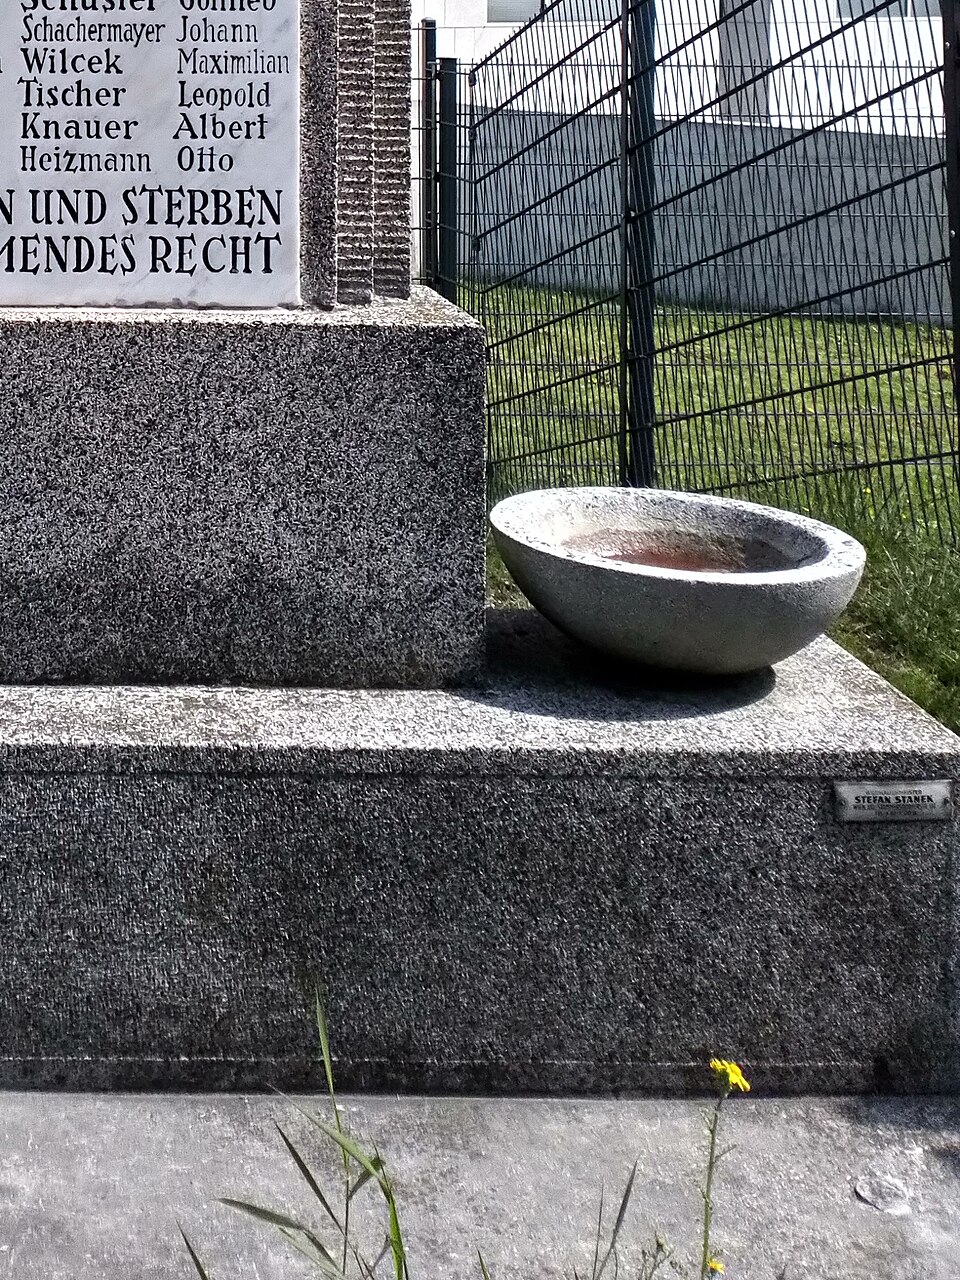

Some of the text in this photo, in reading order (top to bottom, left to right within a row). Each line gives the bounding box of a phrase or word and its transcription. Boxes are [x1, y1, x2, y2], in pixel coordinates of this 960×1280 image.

[20, 15, 259, 48] Schachermayer Johann
[19, 47, 290, 75] Wilcek Maximilian
[16, 77, 272, 112] Tischer Leopold
[20, 111, 269, 141] Knauer Albert
[19, 145, 234, 175] Heizmann Otto
[28, 188, 107, 226] UND
[121, 184, 284, 229] STERBEN
[148, 231, 283, 278] RECHT
[854, 795, 891, 804] STEFAN
